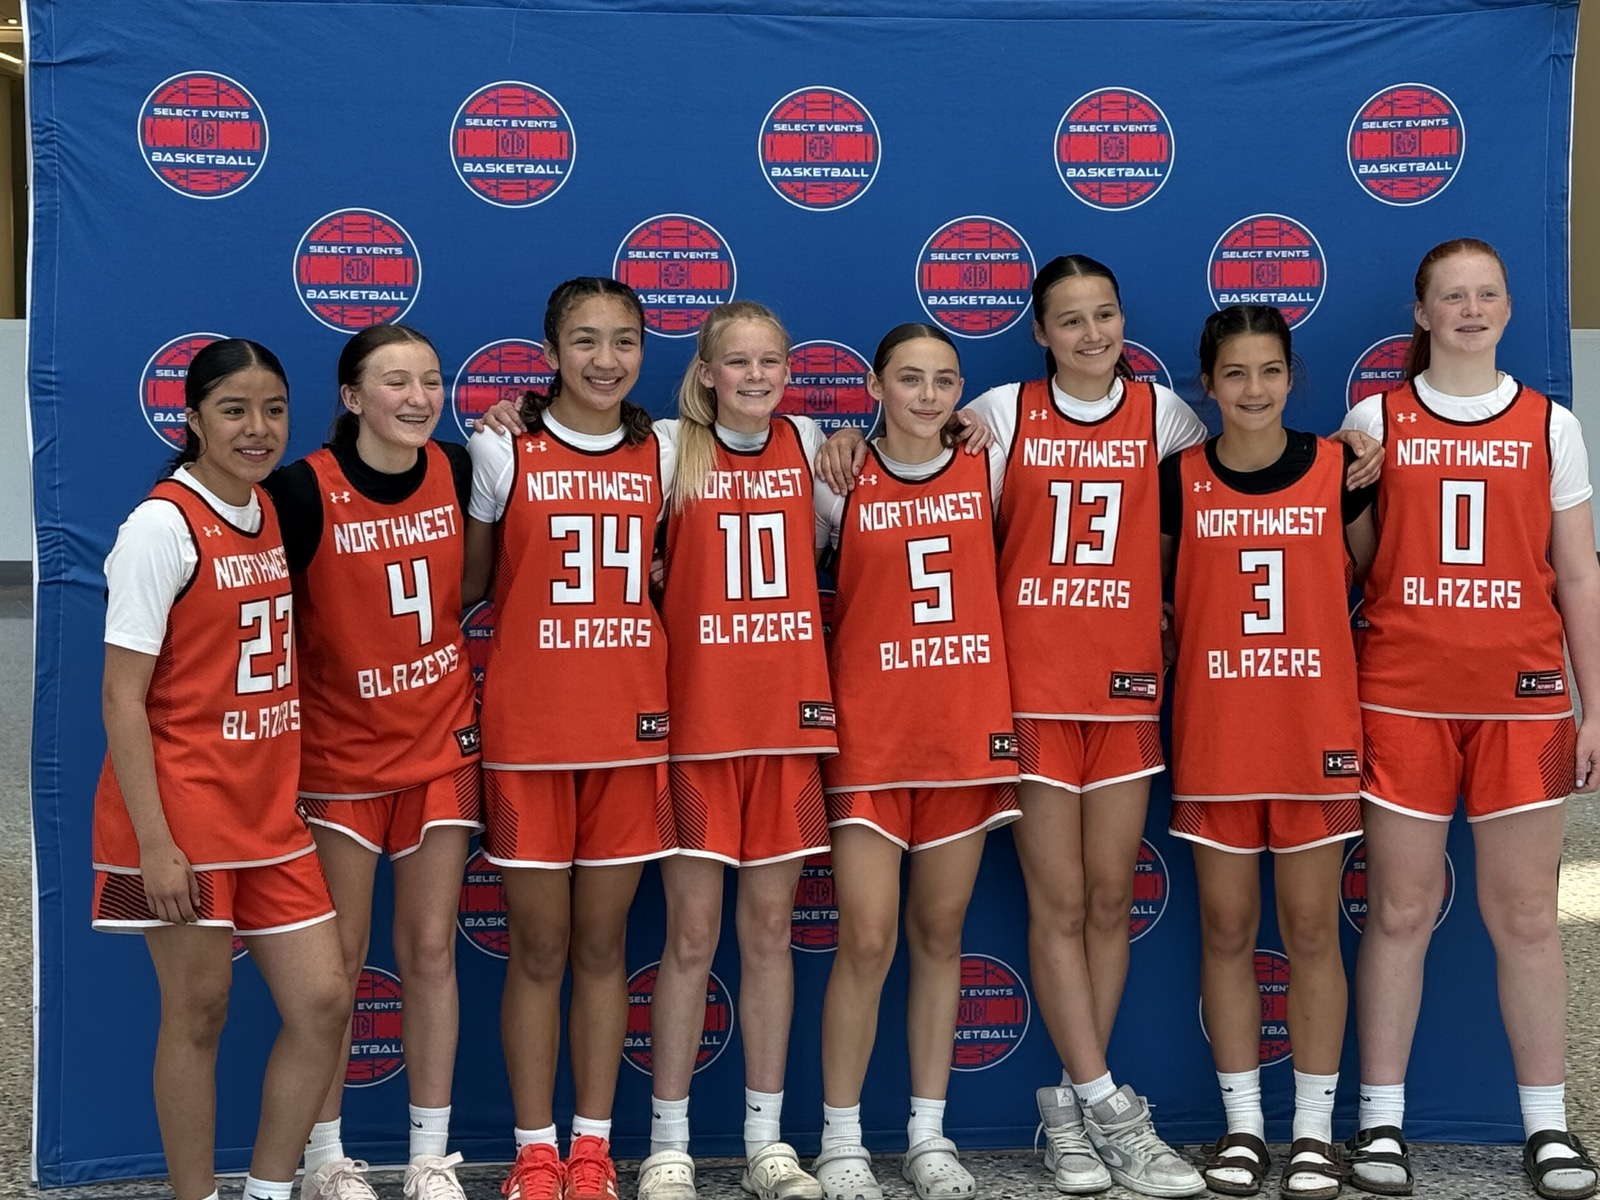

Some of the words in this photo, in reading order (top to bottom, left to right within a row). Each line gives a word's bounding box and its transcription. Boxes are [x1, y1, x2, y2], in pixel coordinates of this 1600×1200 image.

[153, 108, 198, 117] SELECT
[202, 109, 249, 119] EVENTS
[465, 118, 507, 127] SELECT
[511, 120, 557, 128] EVENTS
[773, 124, 815, 132] SELECT
[818, 124, 863, 132] EVENTS
[1069, 124, 1111, 132] SELECT
[1362, 120, 1402, 129] SELECT
[1405, 118, 1449, 128] EVENTS
[152, 152, 256, 166] BASKETBALL
[463, 163, 563, 175] BASKETBALL
[771, 167, 869, 178] BASKETBALL
[1066, 167, 1163, 178] BASKETBALL
[1358, 160, 1453, 174] BASKETBALL
[309, 245, 352, 254] SELECT
[356, 246, 403, 255] EVENTS
[628, 251, 670, 259] SELECT
[673, 251, 719, 259] EVENTS
[1222, 250, 1263, 259] SELECT
[1266, 249, 1310, 258] EVENTS
[306, 289, 409, 301] BASKETBALL
[637, 294, 725, 304] ASKETBALL
[927, 295, 1025, 305] BASKETBALL
[1219, 292, 1315, 303] BASKETBALL
[155, 369, 188, 377] SELE
[467, 375, 511, 383] SELECT
[1361, 371, 1402, 379] SELECT
[1023, 438, 1148, 468] NORTHWEST
[1396, 438, 1533, 470] NORTHWEST
[527, 471, 653, 504] NORTHWEST
[697, 468, 802, 500] ORTHWEST
[859, 491, 983, 532] NORTHWEST
[1049, 480, 1123, 566] 13
[1196, 506, 1327, 538] NORTHWEST
[1440, 479, 1487, 566] 0
[333, 504, 457, 555] NORTHWEST
[549, 514, 643, 605] 34
[718, 511, 790, 601] 10
[906, 535, 955, 625] 5
[1017, 577, 1131, 609] BLAZERS
[1239, 549, 1287, 636] 3
[1403, 576, 1522, 609] BLAZERS
[385, 557, 434, 647] 4
[538, 617, 652, 650] BLAZERS
[699, 610, 813, 646] BLAZERS
[236, 592, 294, 696] 23
[879, 634, 991, 672] BLAZERS
[357, 643, 459, 699] BLAZERS
[1207, 648, 1322, 680] BLAZERS
[467, 875, 503, 883] SELEC
[969, 988, 1014, 996] EVENTS
[357, 1002, 403, 1010] EVENTS
[953, 1029, 1018, 1040] KETBALL
